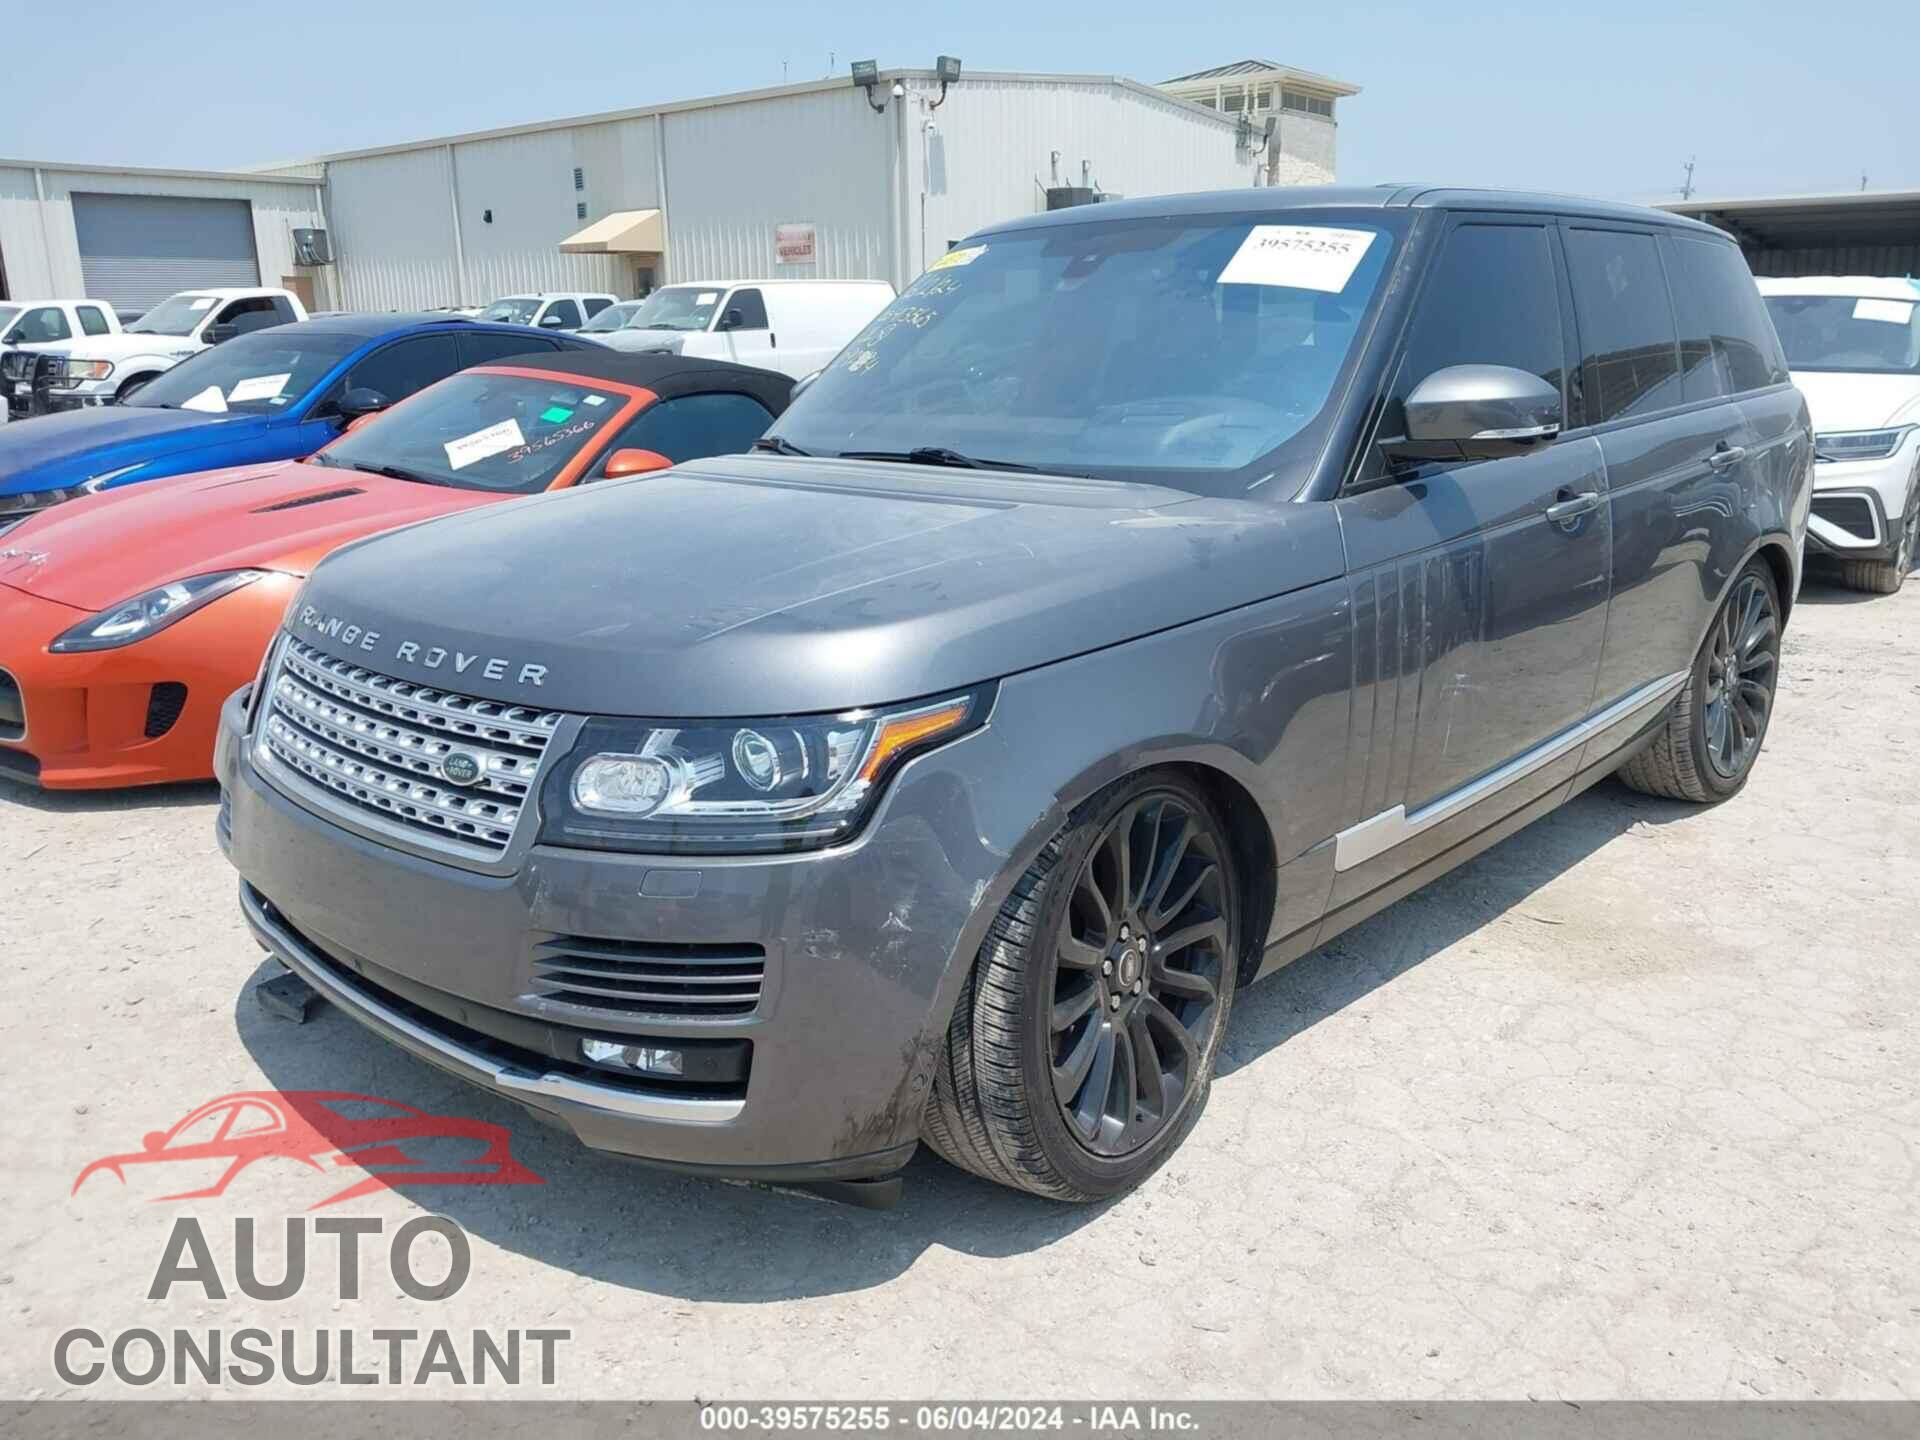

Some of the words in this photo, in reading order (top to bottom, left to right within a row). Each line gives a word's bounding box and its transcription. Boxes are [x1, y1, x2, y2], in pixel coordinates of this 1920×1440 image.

[1255, 238, 1353, 255] 39575255
[507, 420, 596, 464] 39565366
[300, 605, 381, 651] RANGE
[396, 640, 550, 686] ROVER
